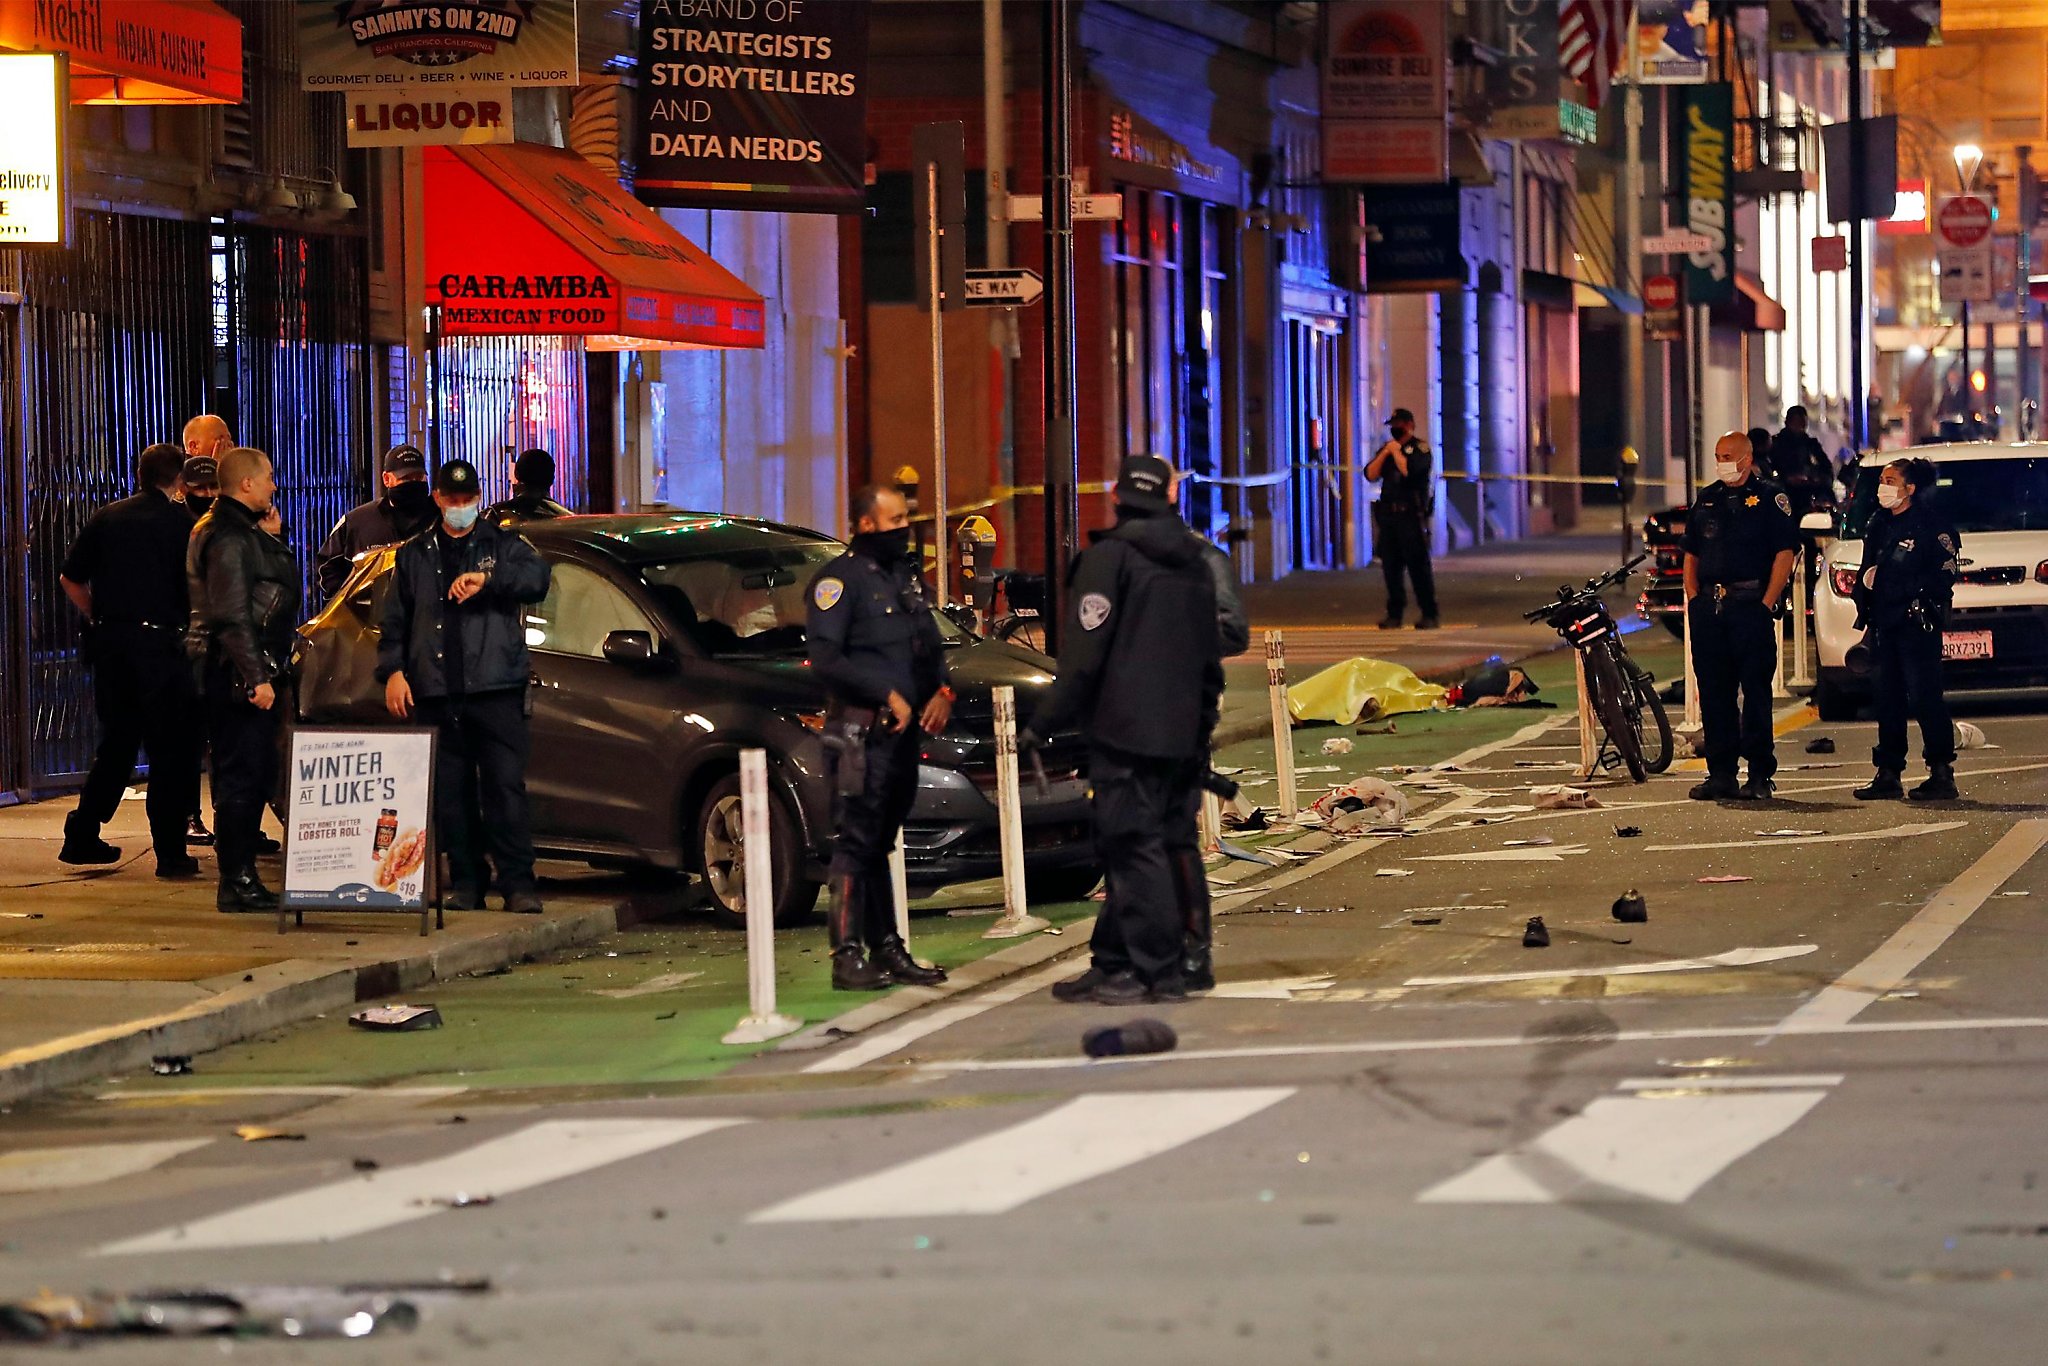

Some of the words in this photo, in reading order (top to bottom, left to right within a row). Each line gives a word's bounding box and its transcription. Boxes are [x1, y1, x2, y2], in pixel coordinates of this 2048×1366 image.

[352, 7, 441, 41] SAMMY'S
[446, 8, 472, 30] ON
[476, 11, 517, 38] 2ND
[652, 0, 671, 16] A
[680, 0, 756, 20] BAND
[765, 0, 802, 23] OF
[115, 19, 157, 68] INDIAN
[160, 31, 206, 80] CUISINE
[652, 28, 832, 60] STRATEGISTS
[308, 74, 371, 85] GOURMET
[375, 74, 404, 84] DELI
[420, 72, 455, 83] BEER
[470, 71, 505, 82] WINE
[520, 70, 569, 81] LIQUOR
[651, 63, 856, 96] STORYTELLERS
[1331, 57, 1393, 76] SUNRISE
[1402, 57, 1432, 76] DELI
[355, 101, 503, 133] LIQUOR
[650, 99, 712, 123] AND
[650, 133, 725, 159] DATA
[730, 136, 823, 163] NERDS
[1687, 104, 1727, 282] SUBWAY
[439, 274, 612, 299] CARAMBA
[965, 282, 983, 295] NE
[989, 281, 1018, 294] WAY
[446, 307, 542, 326] MEXICAN
[550, 307, 606, 324] FOOD
[299, 751, 382, 782] WINTER
[300, 788, 313, 801] AT
[321, 777, 395, 807] LUKE'S
[298, 828, 337, 841] LOBSTER
[339, 826, 361, 837] ROLL
[399, 881, 416, 896] $19
